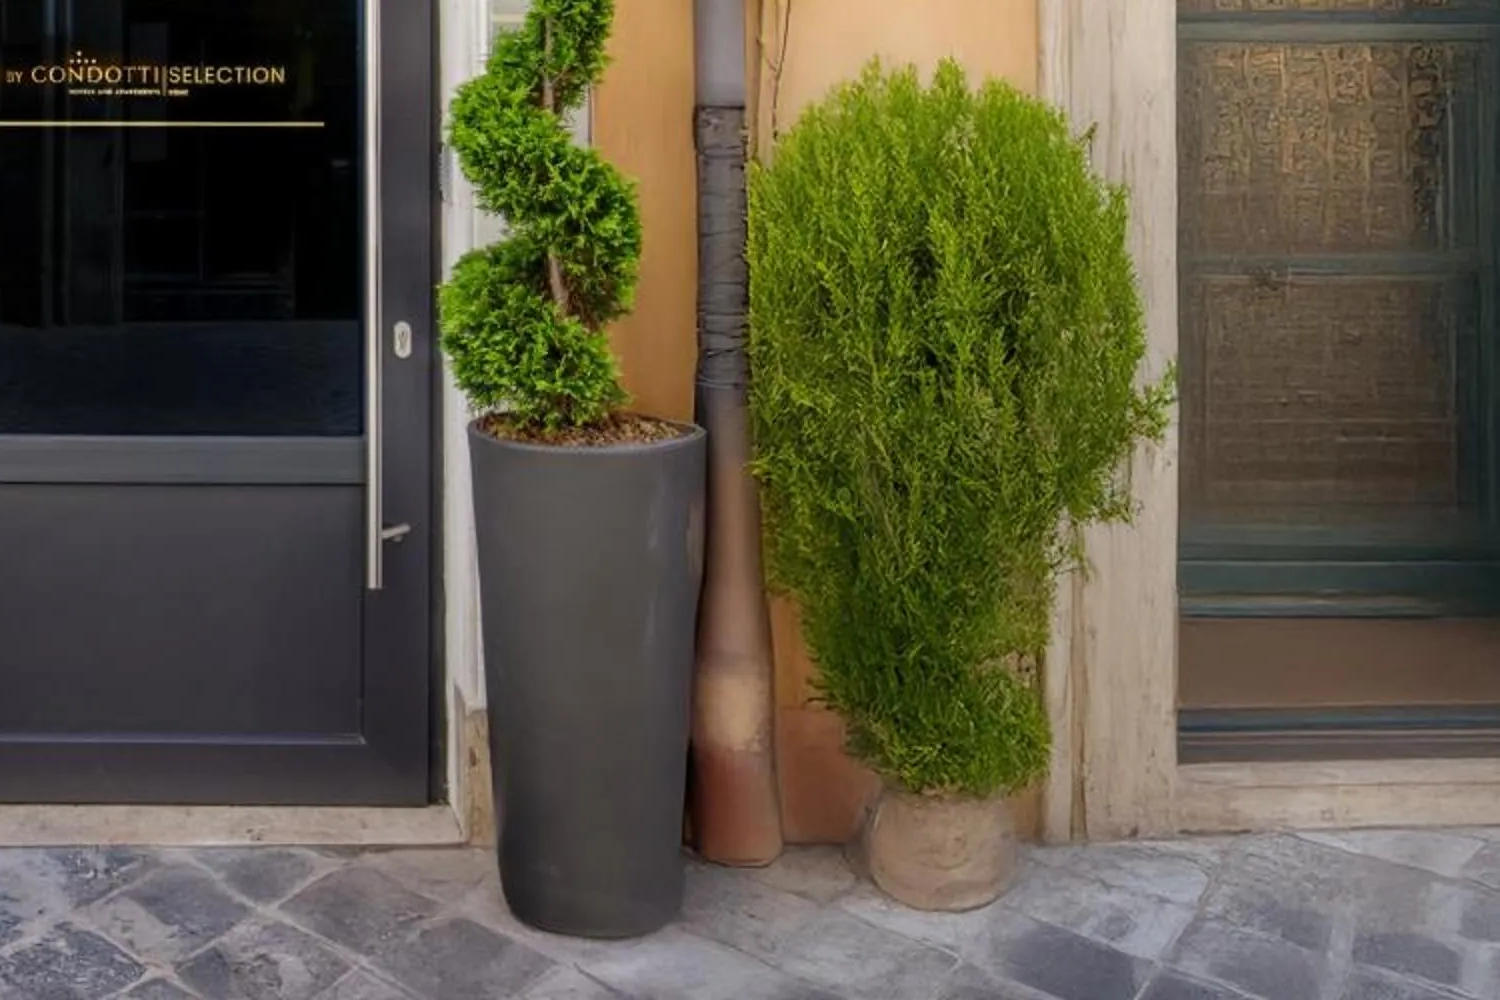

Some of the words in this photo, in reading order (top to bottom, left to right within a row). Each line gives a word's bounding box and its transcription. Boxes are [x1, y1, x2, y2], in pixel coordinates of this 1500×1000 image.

[5, 70, 23, 83] BY
[31, 65, 159, 83] CONDOTTI
[168, 65, 286, 84] SELECTION
